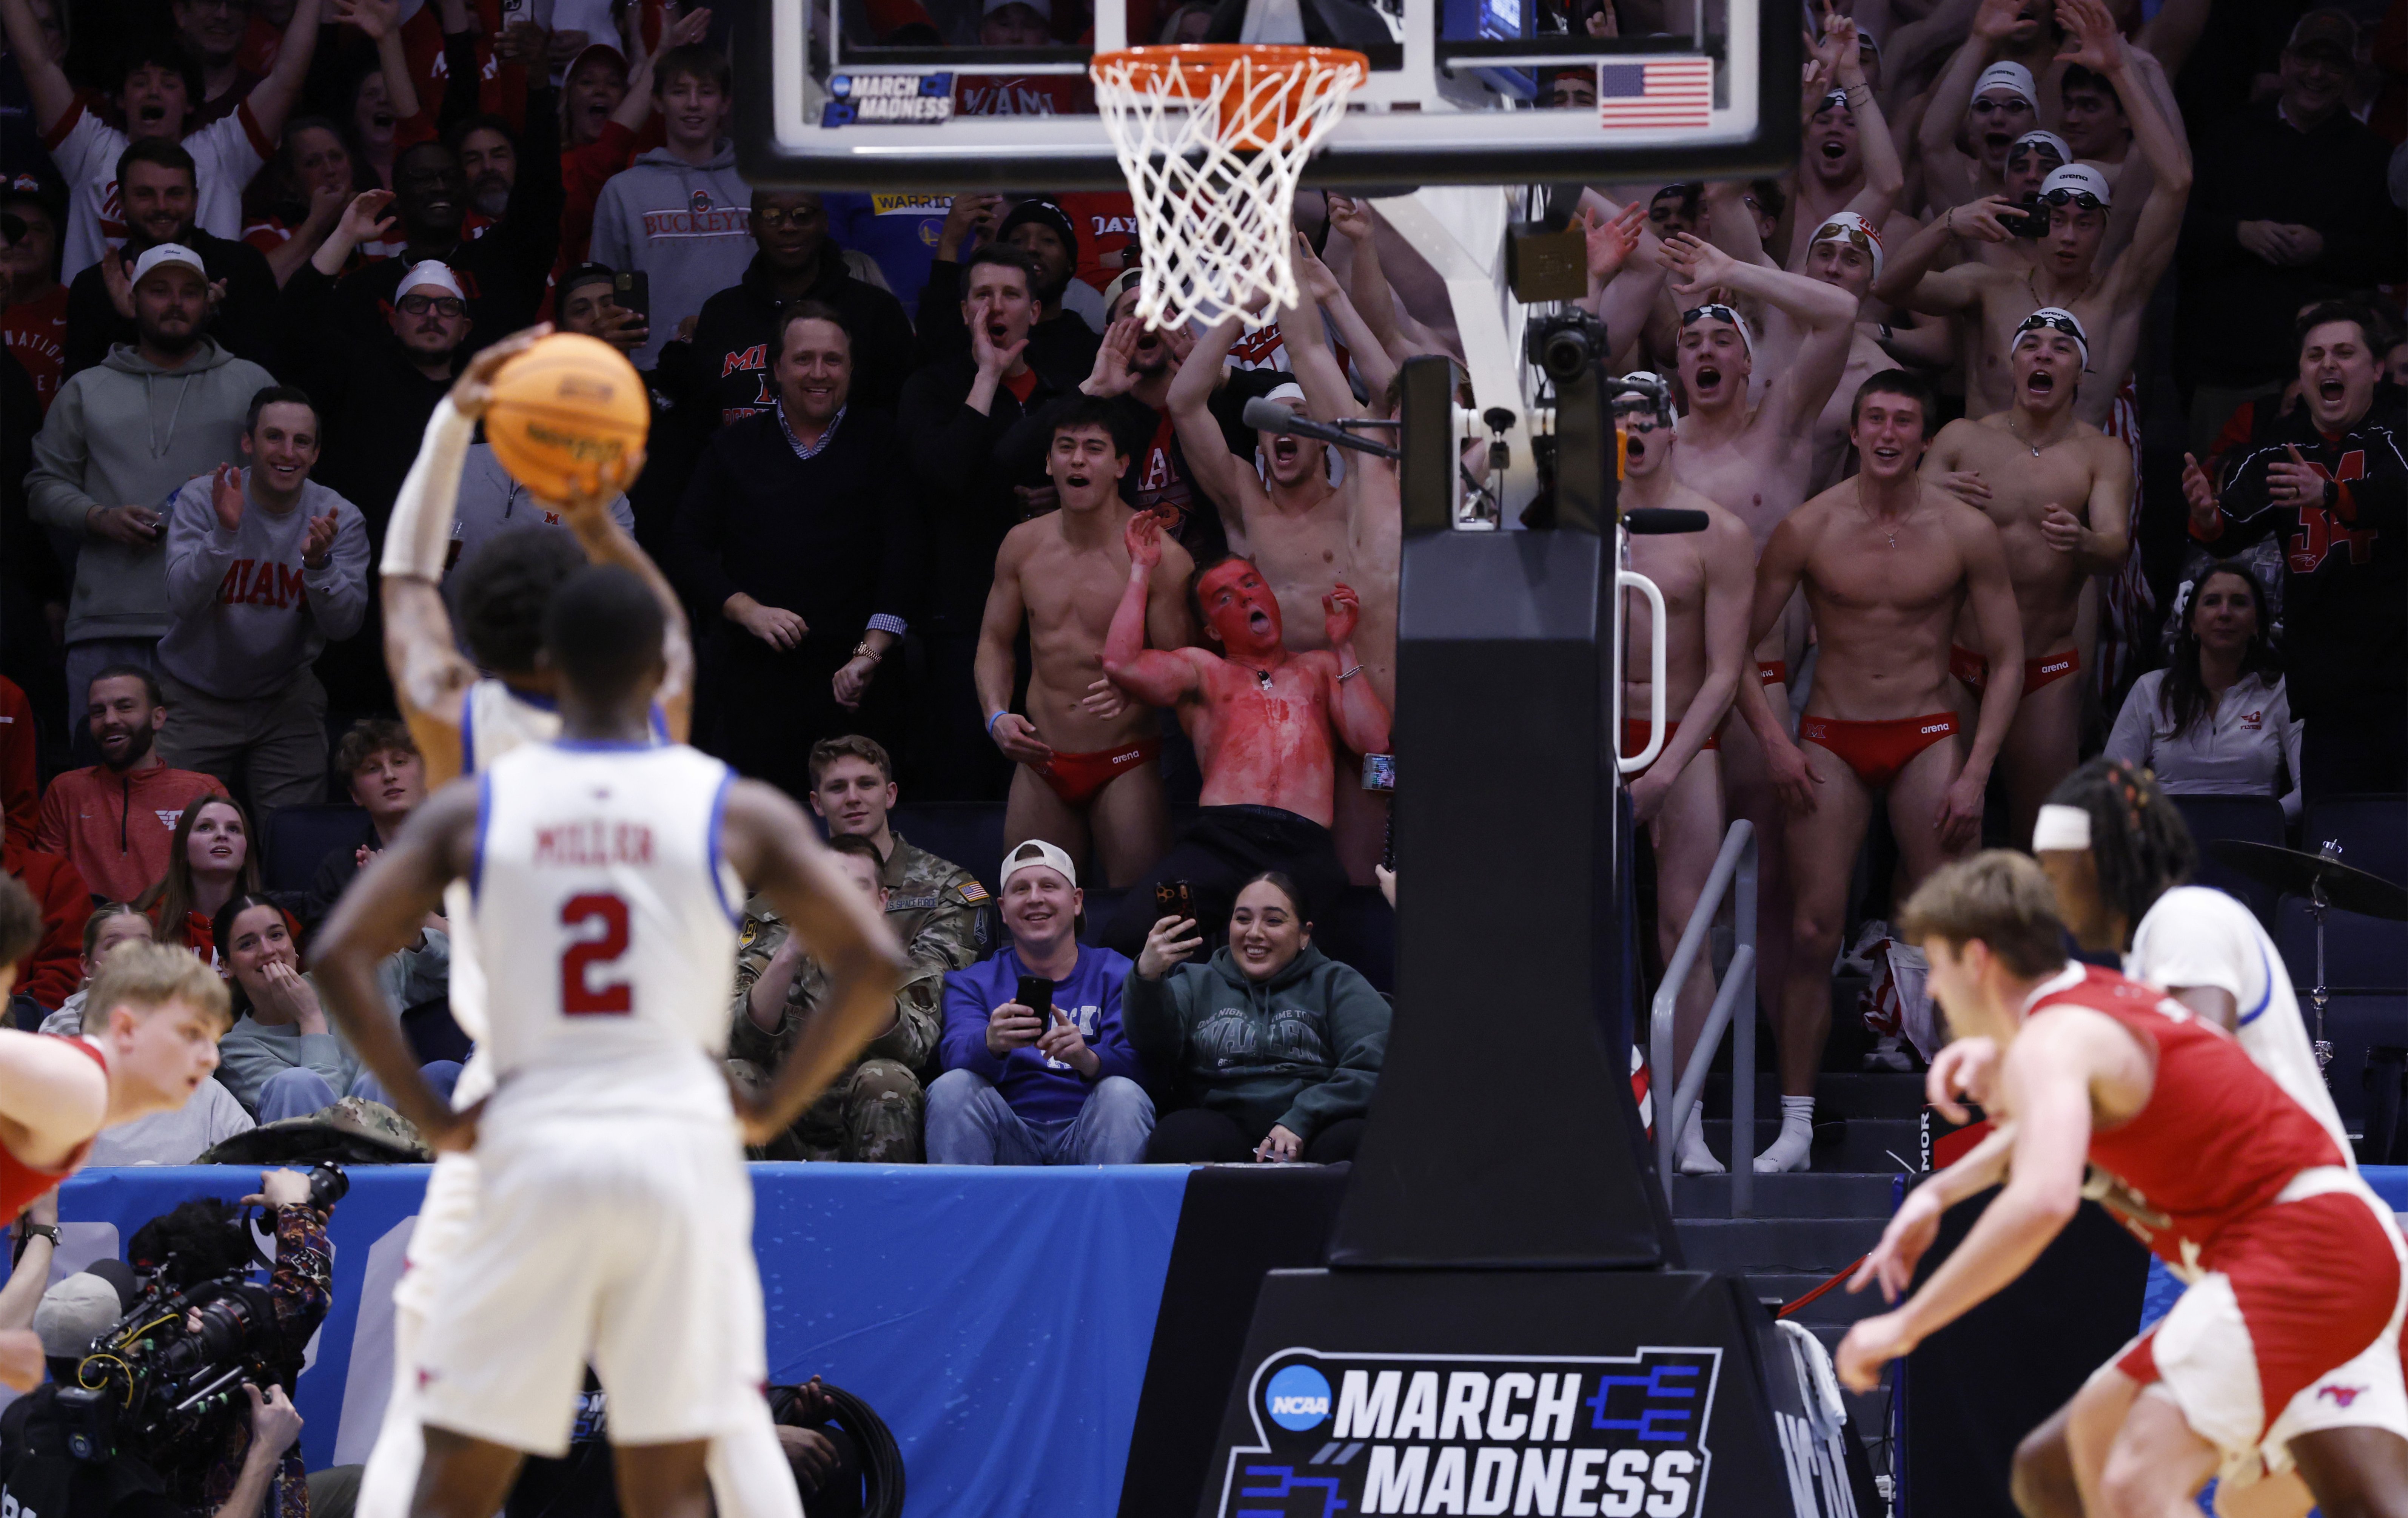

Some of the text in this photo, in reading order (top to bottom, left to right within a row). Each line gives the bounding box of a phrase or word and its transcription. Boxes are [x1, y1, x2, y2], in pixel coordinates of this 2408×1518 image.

[850, 75, 920, 97] MARCH
[857, 97, 951, 119] MADNESS
[878, 195, 955, 208] WARRIO
[1091, 216, 1137, 236] DAY
[2041, 311, 2069, 320] arena
[542, 510, 562, 527] M
[2041, 661, 2069, 674] arena
[1921, 723, 1949, 734] arena
[1112, 750, 1140, 764] arena
[533, 820, 655, 865] MILLER
[896, 899, 916, 908] SPACE
[918, 898, 936, 907] FORCE
[559, 892, 633, 1017] 2
[1272, 1396, 1329, 1415] NCAA
[1332, 1370, 1582, 1441] MARCH
[1360, 1445, 1696, 1518] MADNESS
